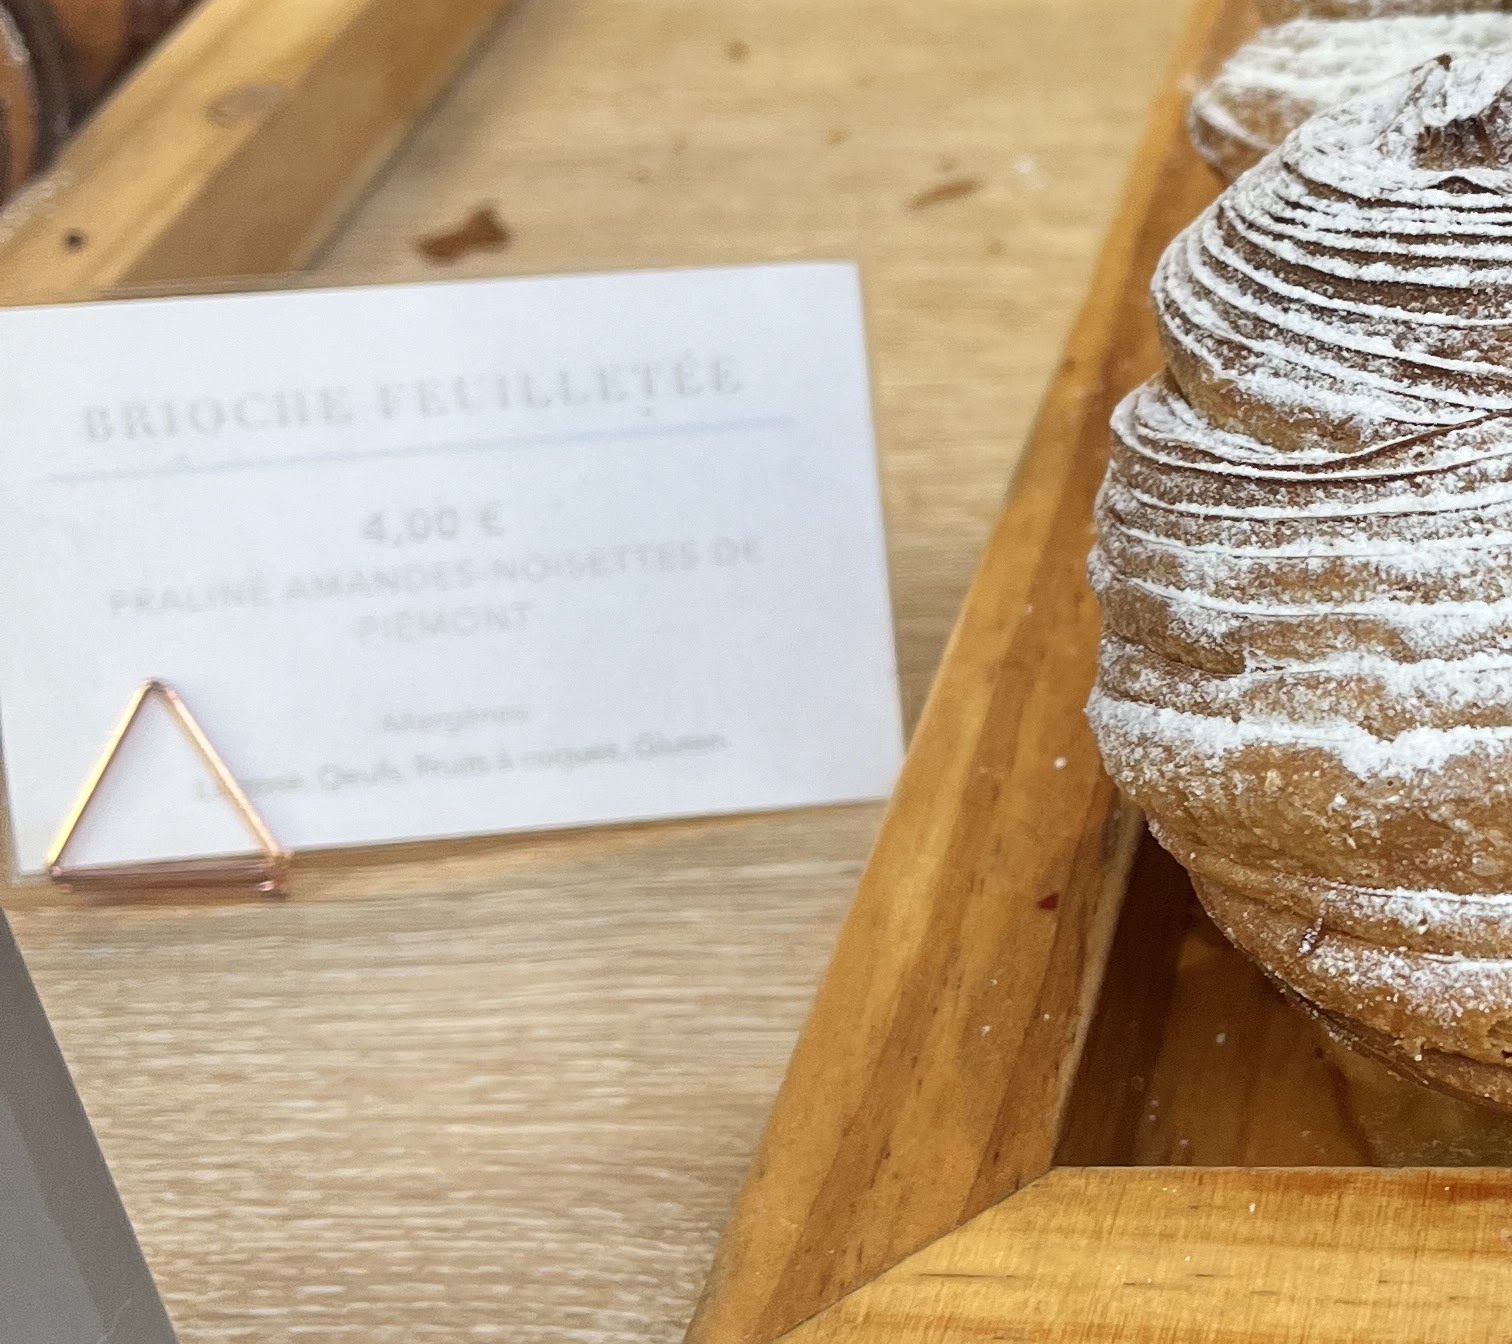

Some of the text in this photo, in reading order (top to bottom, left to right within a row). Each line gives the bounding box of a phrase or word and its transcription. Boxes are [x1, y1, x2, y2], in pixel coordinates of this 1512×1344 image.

[84, 348, 744, 442] BRIOCHE FEUILLETÉE
[360, 501, 506, 549] 4,00 €
[711, 534, 764, 567] DE
